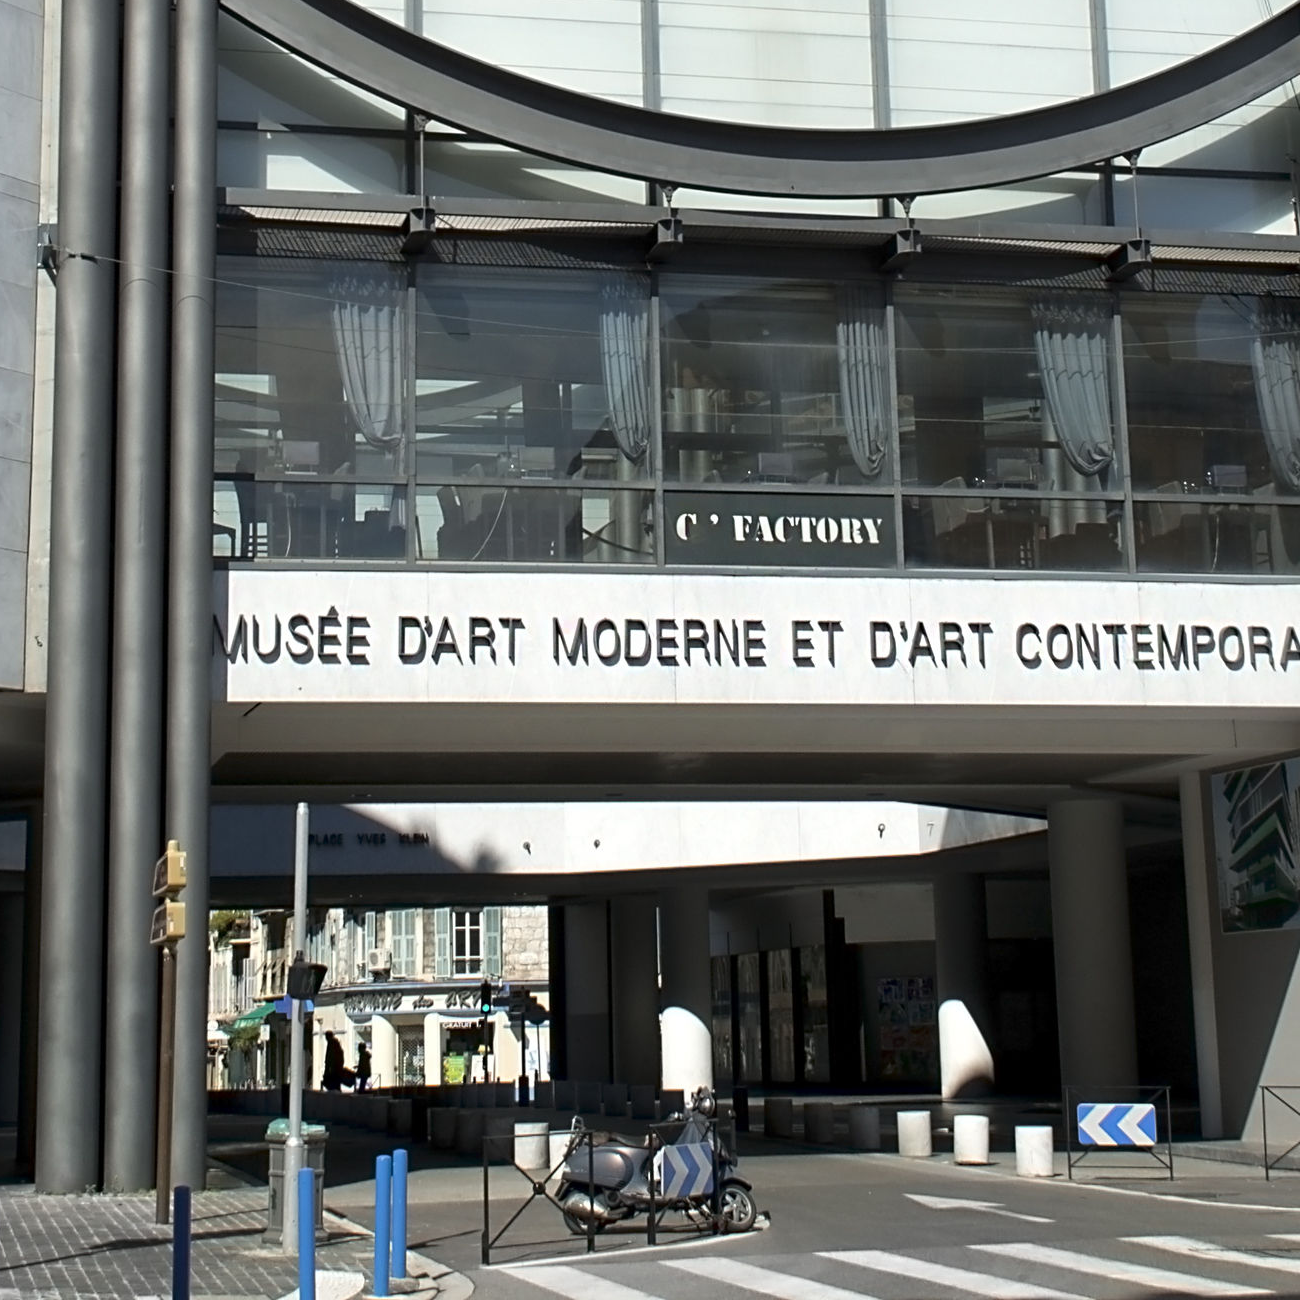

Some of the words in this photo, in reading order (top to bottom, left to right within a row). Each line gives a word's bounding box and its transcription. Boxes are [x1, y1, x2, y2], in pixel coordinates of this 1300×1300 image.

[732, 515, 883, 544] FACTORY
[212, 606, 371, 665] MUSÉE
[399, 616, 526, 666] D'ART
[552, 617, 767, 668] MODERNE
[792, 620, 844, 669] ET
[870, 620, 994, 670] D'ART
